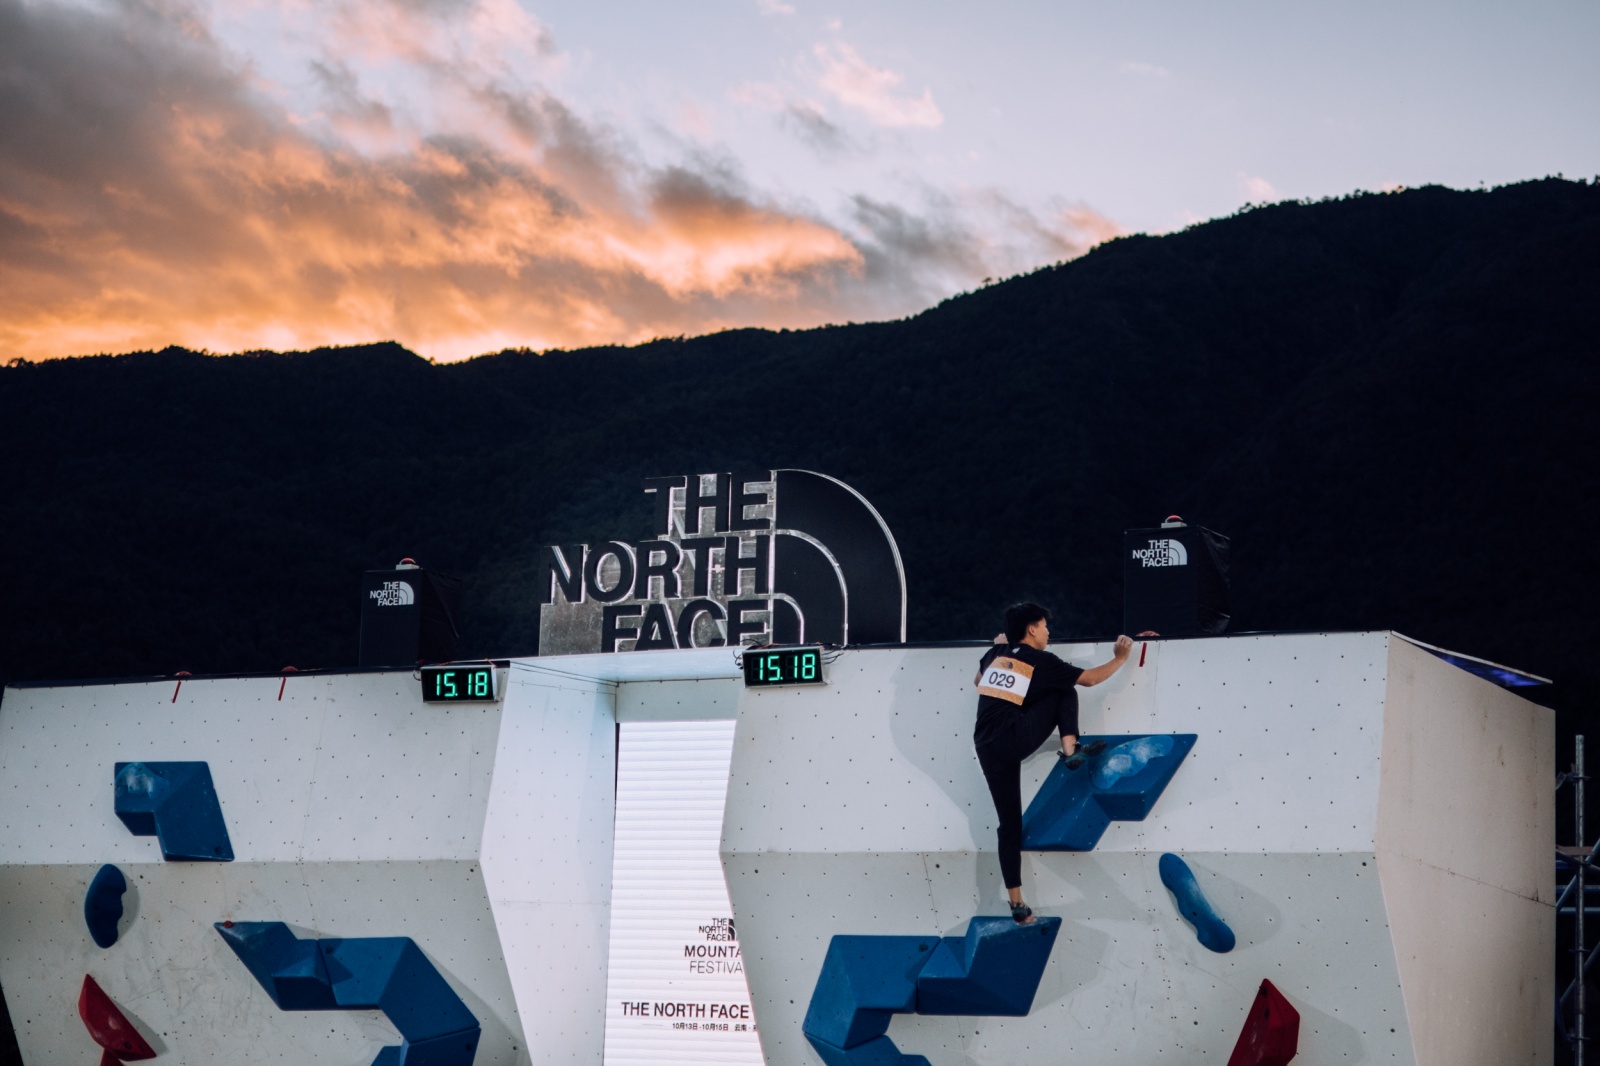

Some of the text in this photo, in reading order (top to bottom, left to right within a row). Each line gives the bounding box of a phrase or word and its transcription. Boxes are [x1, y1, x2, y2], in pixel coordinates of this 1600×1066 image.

[645, 471, 771, 534] THE
[1148, 540, 1168, 549] THE
[1132, 549, 1168, 559] NORTH
[1142, 558, 1168, 568] FACE
[546, 535, 769, 604] NORTH
[383, 582, 399, 590] THE
[370, 590, 399, 599] NORTH
[378, 598, 399, 606] FACE
[601, 598, 769, 651] FACE
[988, 671, 1016, 689] 029
[712, 918, 727, 926] THE
[698, 925, 727, 933] NORTH
[689, 961, 744, 974] FESTIVA
[621, 1002, 749, 1019] THE NORTH FACE
